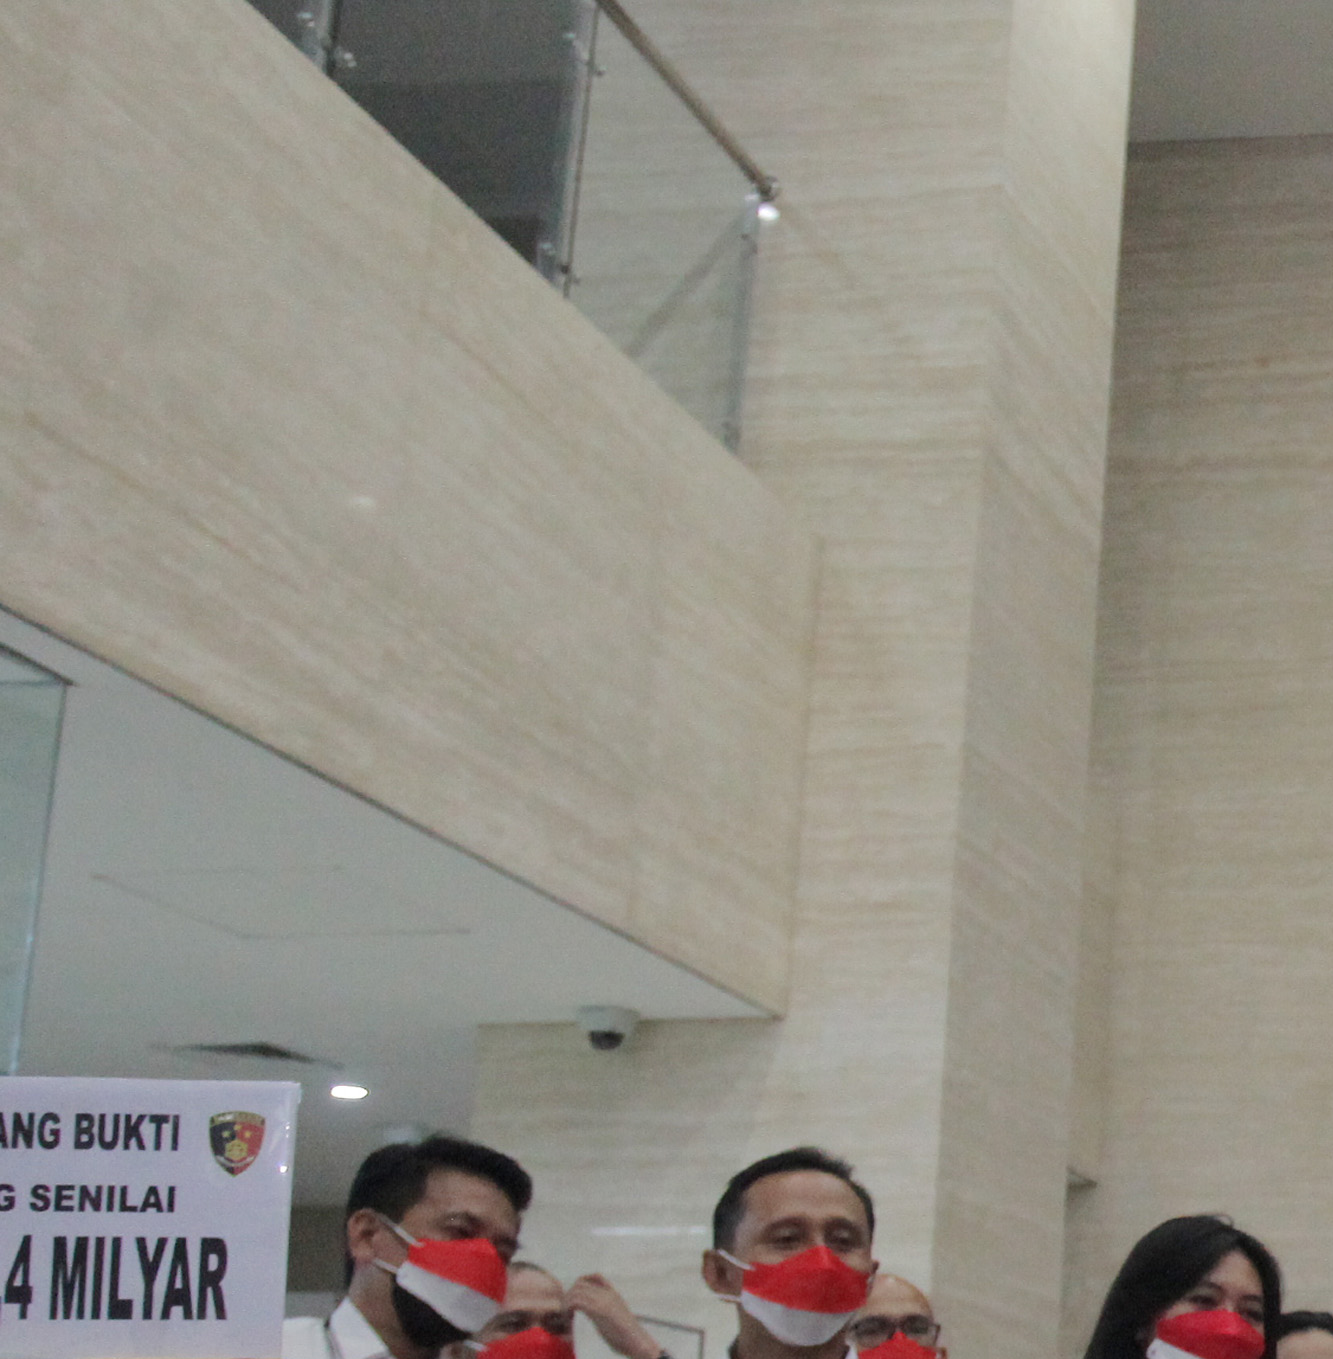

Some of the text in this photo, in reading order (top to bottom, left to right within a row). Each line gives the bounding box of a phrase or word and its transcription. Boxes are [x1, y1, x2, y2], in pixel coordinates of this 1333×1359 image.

[74, 1112, 180, 1151] BUKTI
[29, 1184, 177, 1213] SENILAI
[49, 1235, 229, 1320] MILYAR
